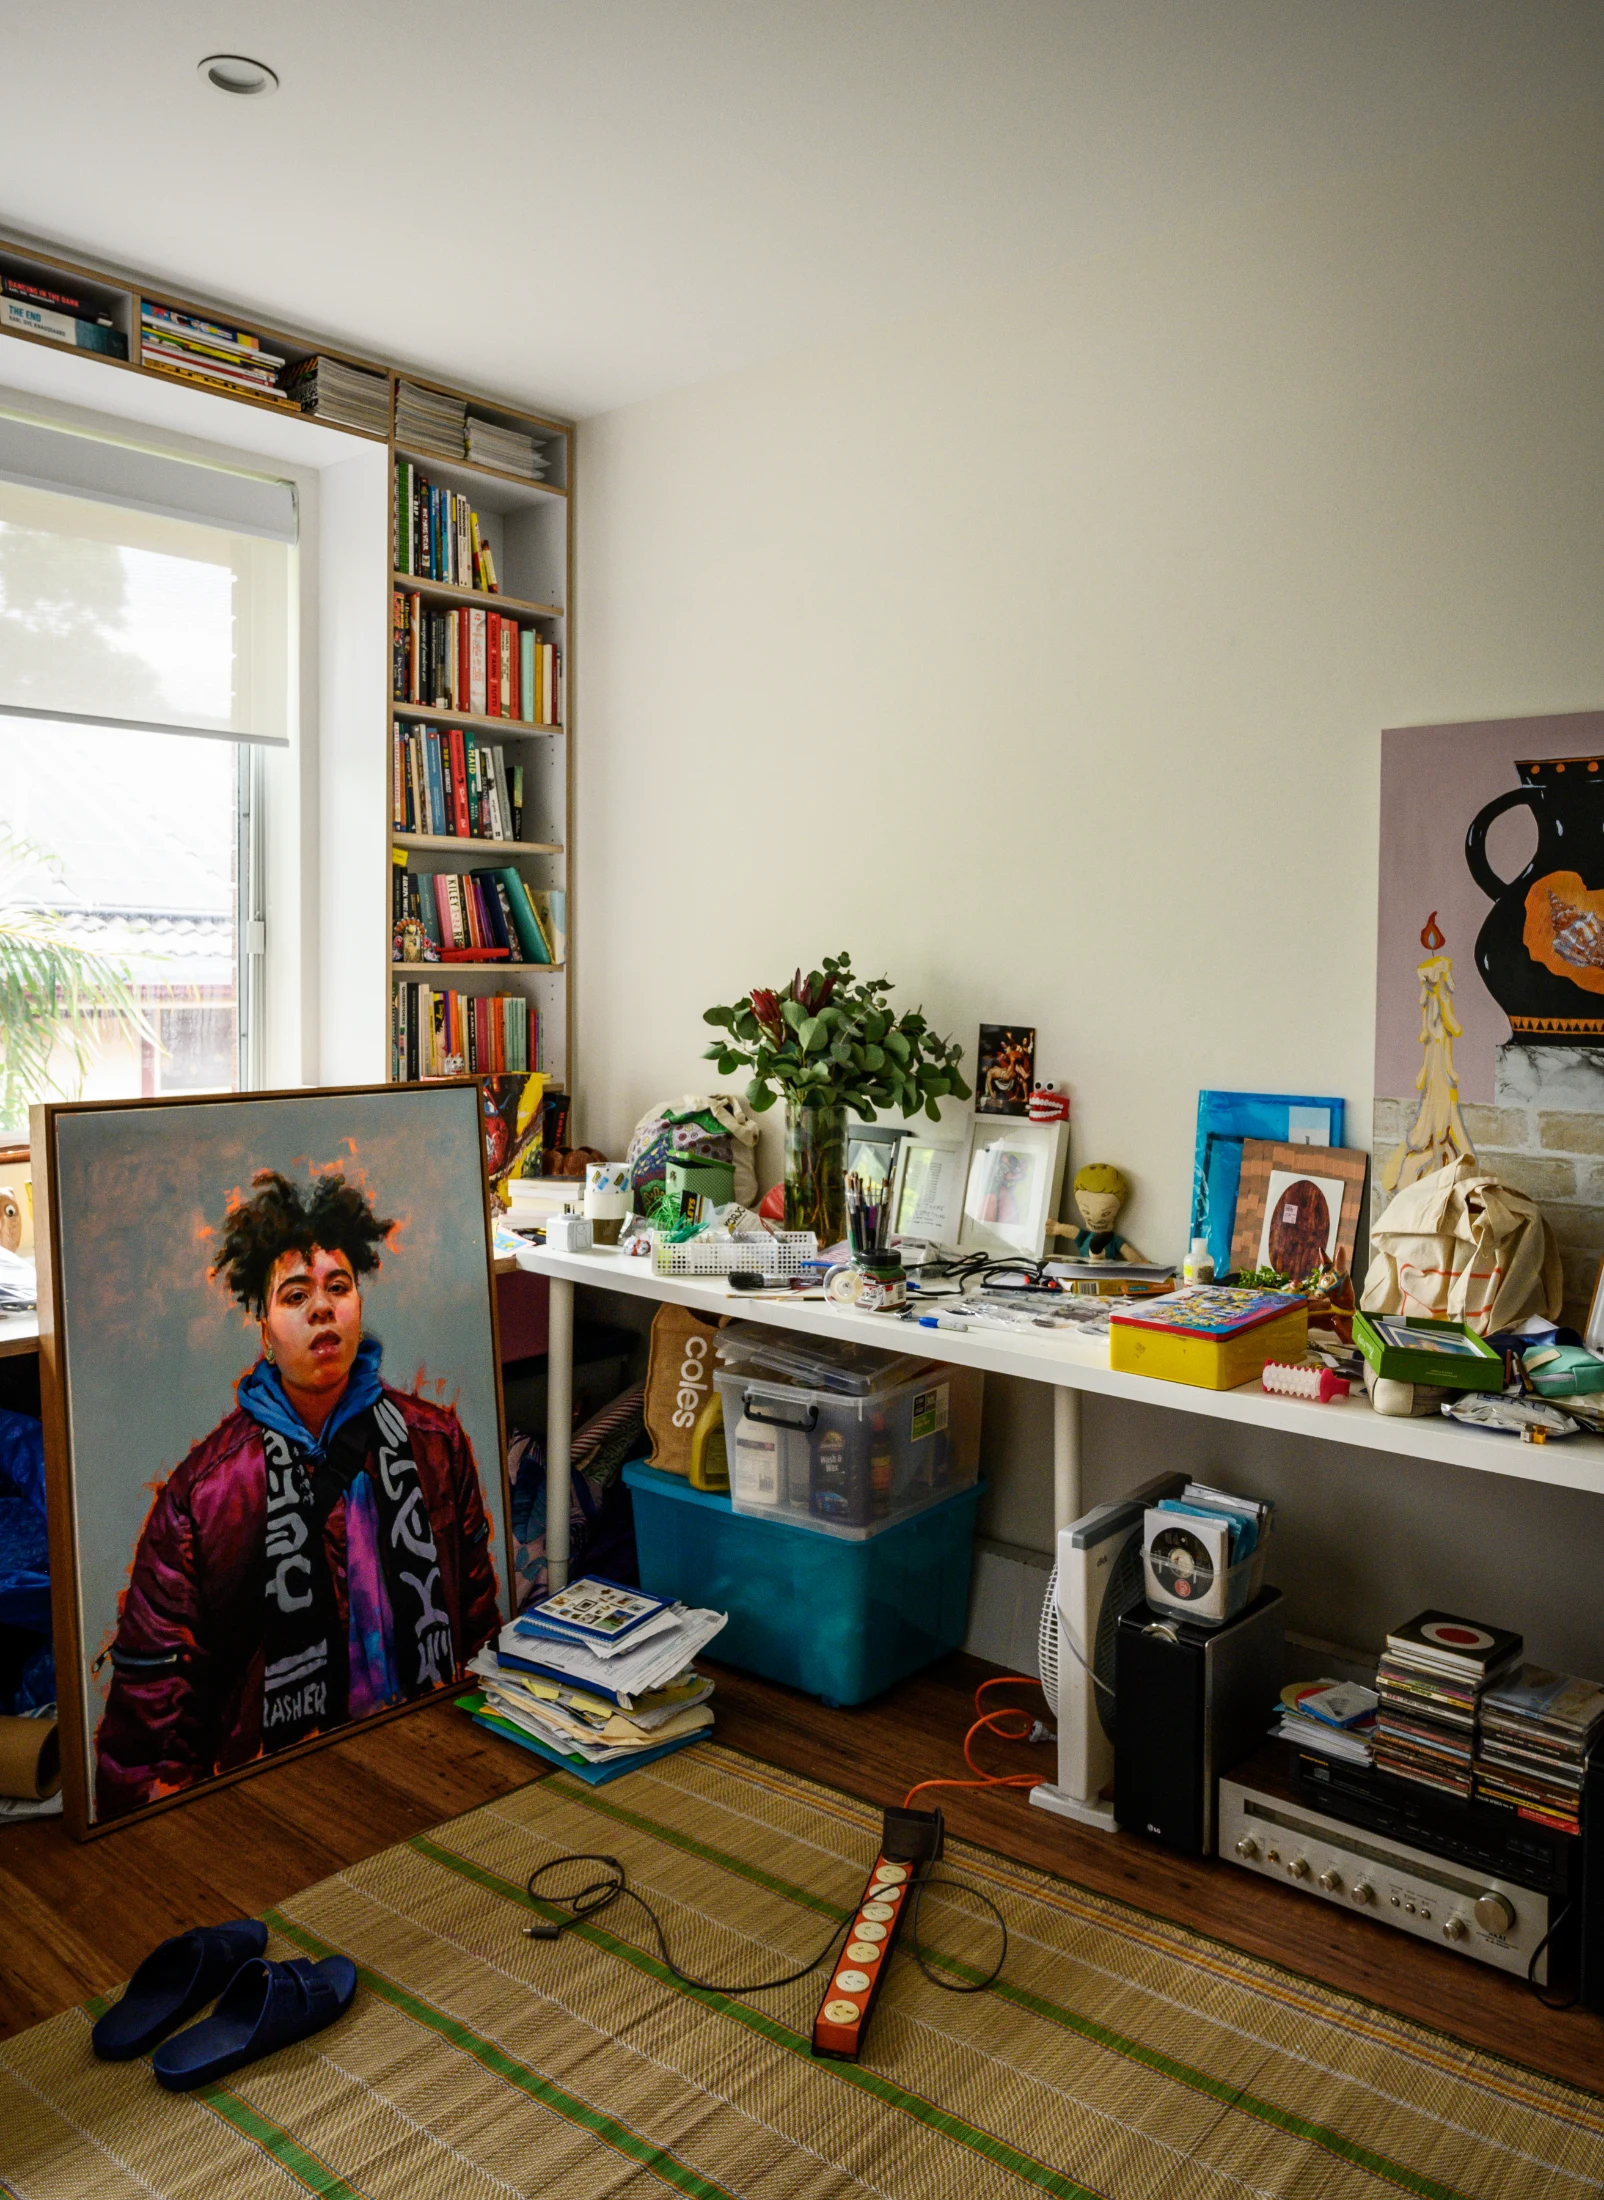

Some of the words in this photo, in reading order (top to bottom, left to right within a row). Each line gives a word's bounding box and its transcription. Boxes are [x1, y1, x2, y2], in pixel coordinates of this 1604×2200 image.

[8, 280, 38, 294] DANCING
[39, 289, 46, 297] IN
[48, 292, 60, 301] THE
[8, 305, 24, 317] THE
[26, 310, 41, 322] END
[9, 316, 21, 324] KARL
[468, 749, 477, 775] MAID
[448, 879, 459, 907] KILEY
[672, 1336, 708, 1428] coles
[820, 1454, 836, 1463] Wash
[825, 1464, 838, 1472] Wax
[263, 1682, 327, 1728] ASHER
